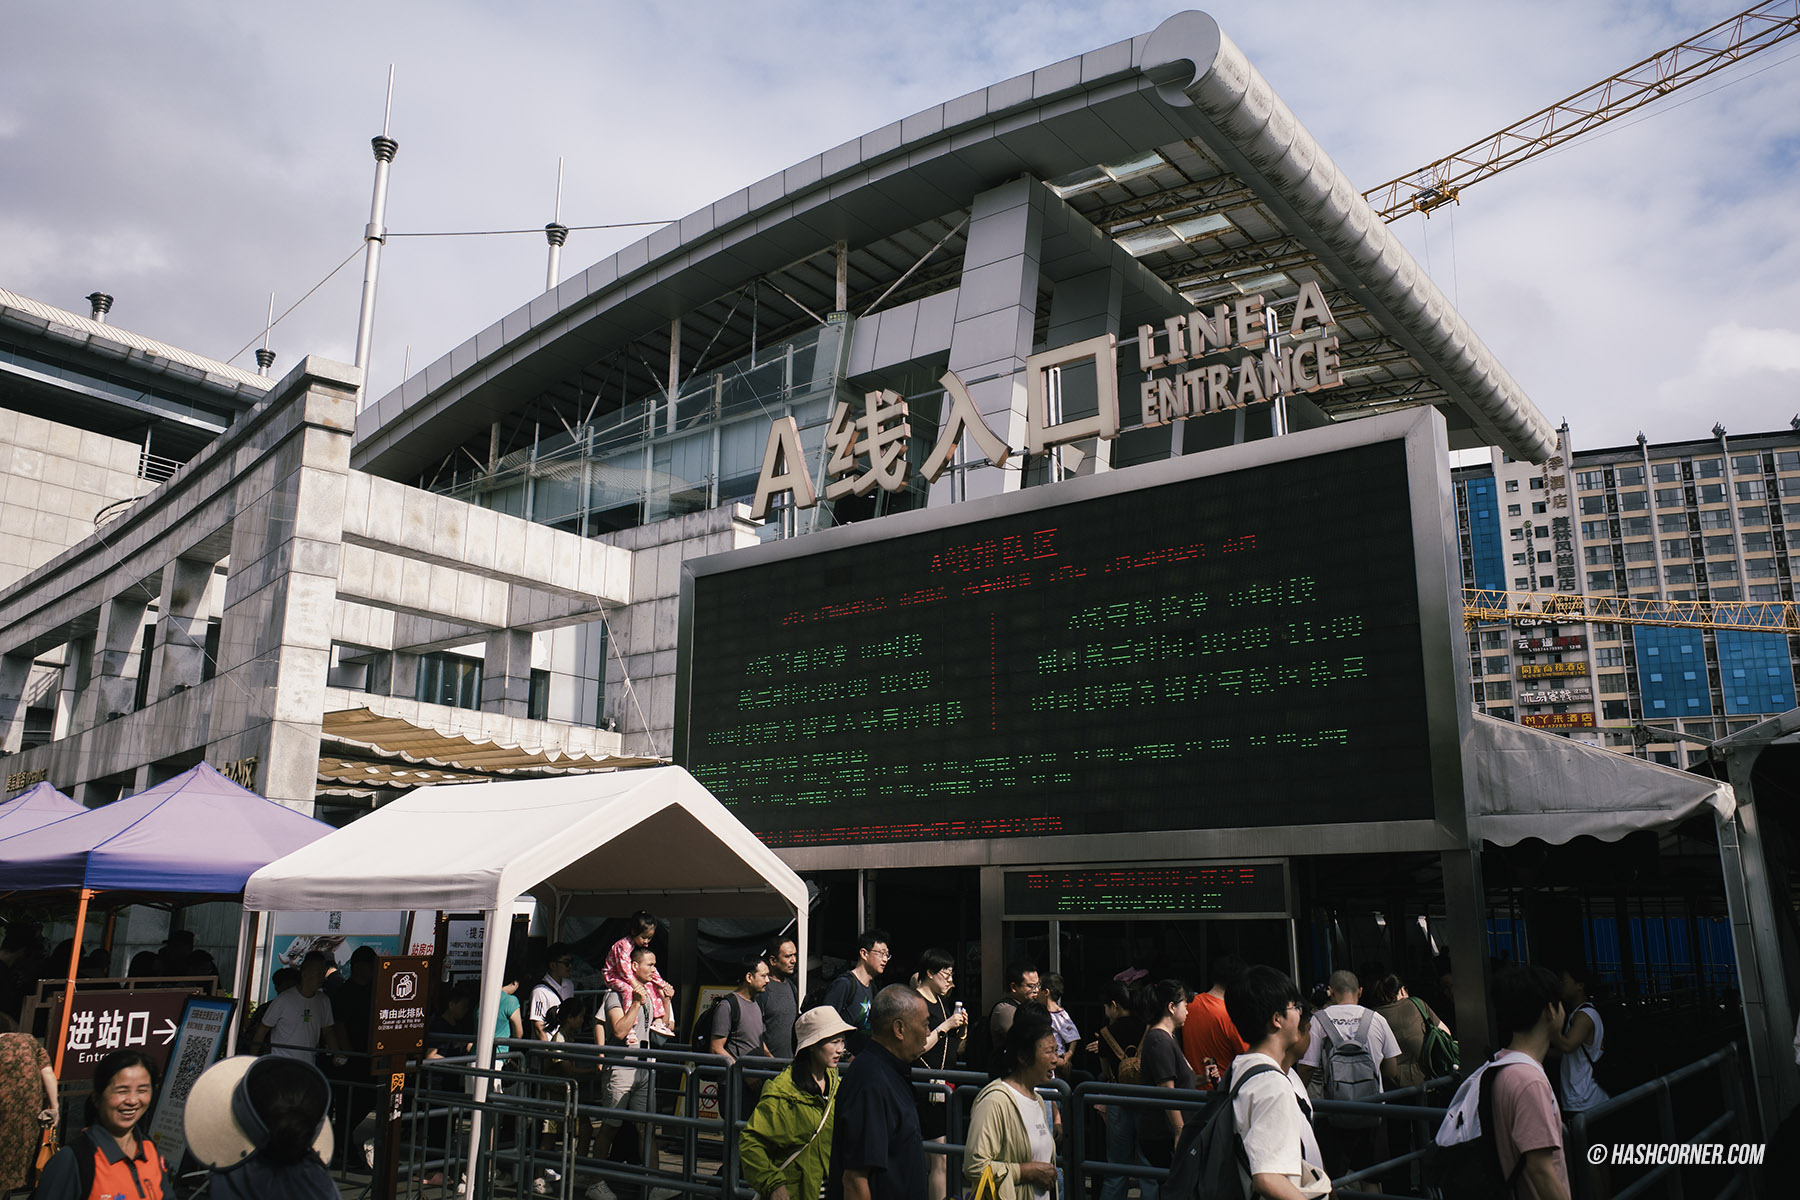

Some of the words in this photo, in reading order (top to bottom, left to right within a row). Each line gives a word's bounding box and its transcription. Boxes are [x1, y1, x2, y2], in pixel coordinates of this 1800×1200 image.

[1138, 295, 1267, 371] LINE
[1290, 281, 1336, 334] A
[1140, 336, 1341, 429] ENTRANCE
[749, 333, 1120, 520] A线入口
[67, 1009, 150, 1051] 进站口
[379, 1007, 425, 1020] 请由此排队
[78, 1051, 110, 1063] Entr
